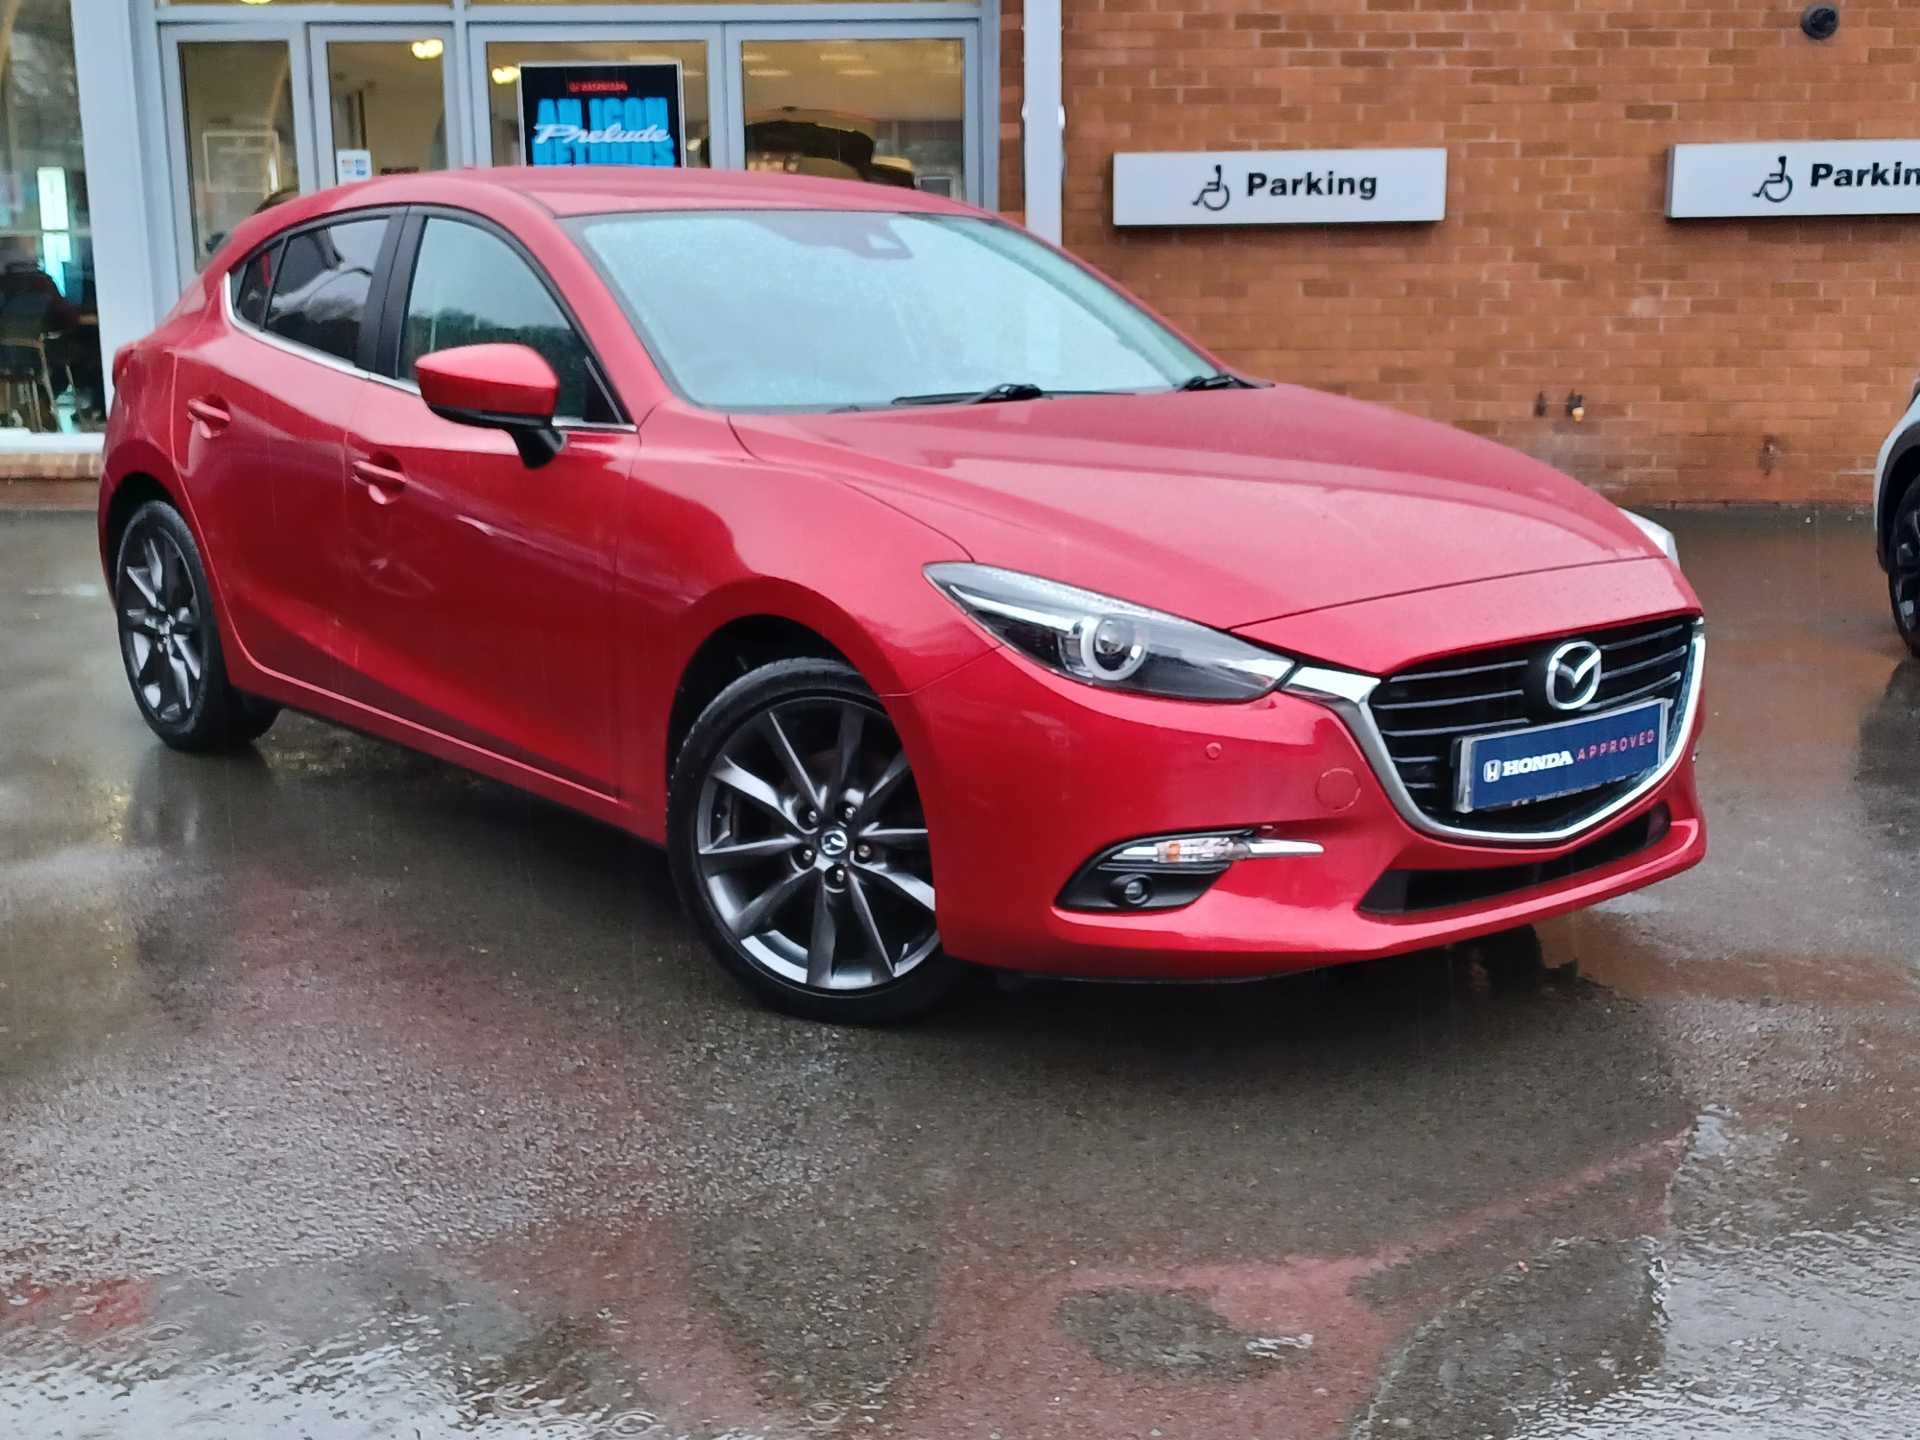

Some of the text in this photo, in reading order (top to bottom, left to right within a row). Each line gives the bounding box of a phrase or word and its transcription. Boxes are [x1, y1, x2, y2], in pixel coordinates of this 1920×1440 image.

[589, 96, 669, 132] ICON
[534, 122, 671, 144] Prelude
[1247, 171, 1378, 200] Parking
[1809, 161, 1920, 188] Parkin
[1502, 729, 1655, 777] HONDA APPROVED
